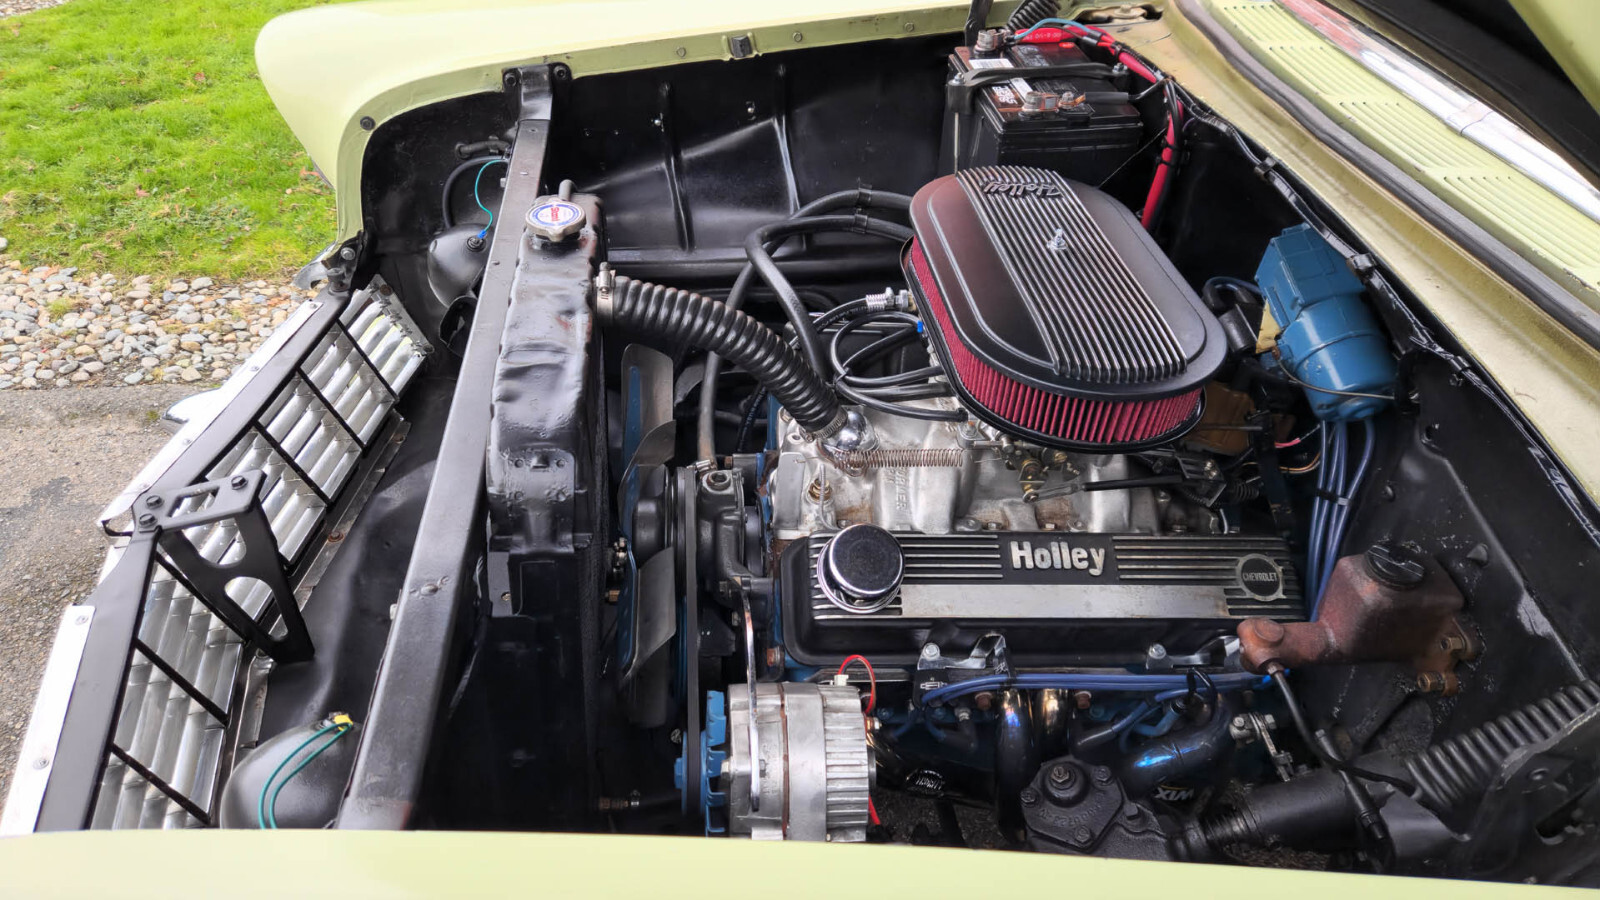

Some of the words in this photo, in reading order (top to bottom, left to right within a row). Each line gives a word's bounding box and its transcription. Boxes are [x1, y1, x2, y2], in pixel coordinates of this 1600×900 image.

[983, 181, 1063, 196] Holley
[1010, 541, 1105, 576] Holley
[1242, 570, 1278, 582] CHEVROLET
[1154, 786, 1194, 801] WIX
